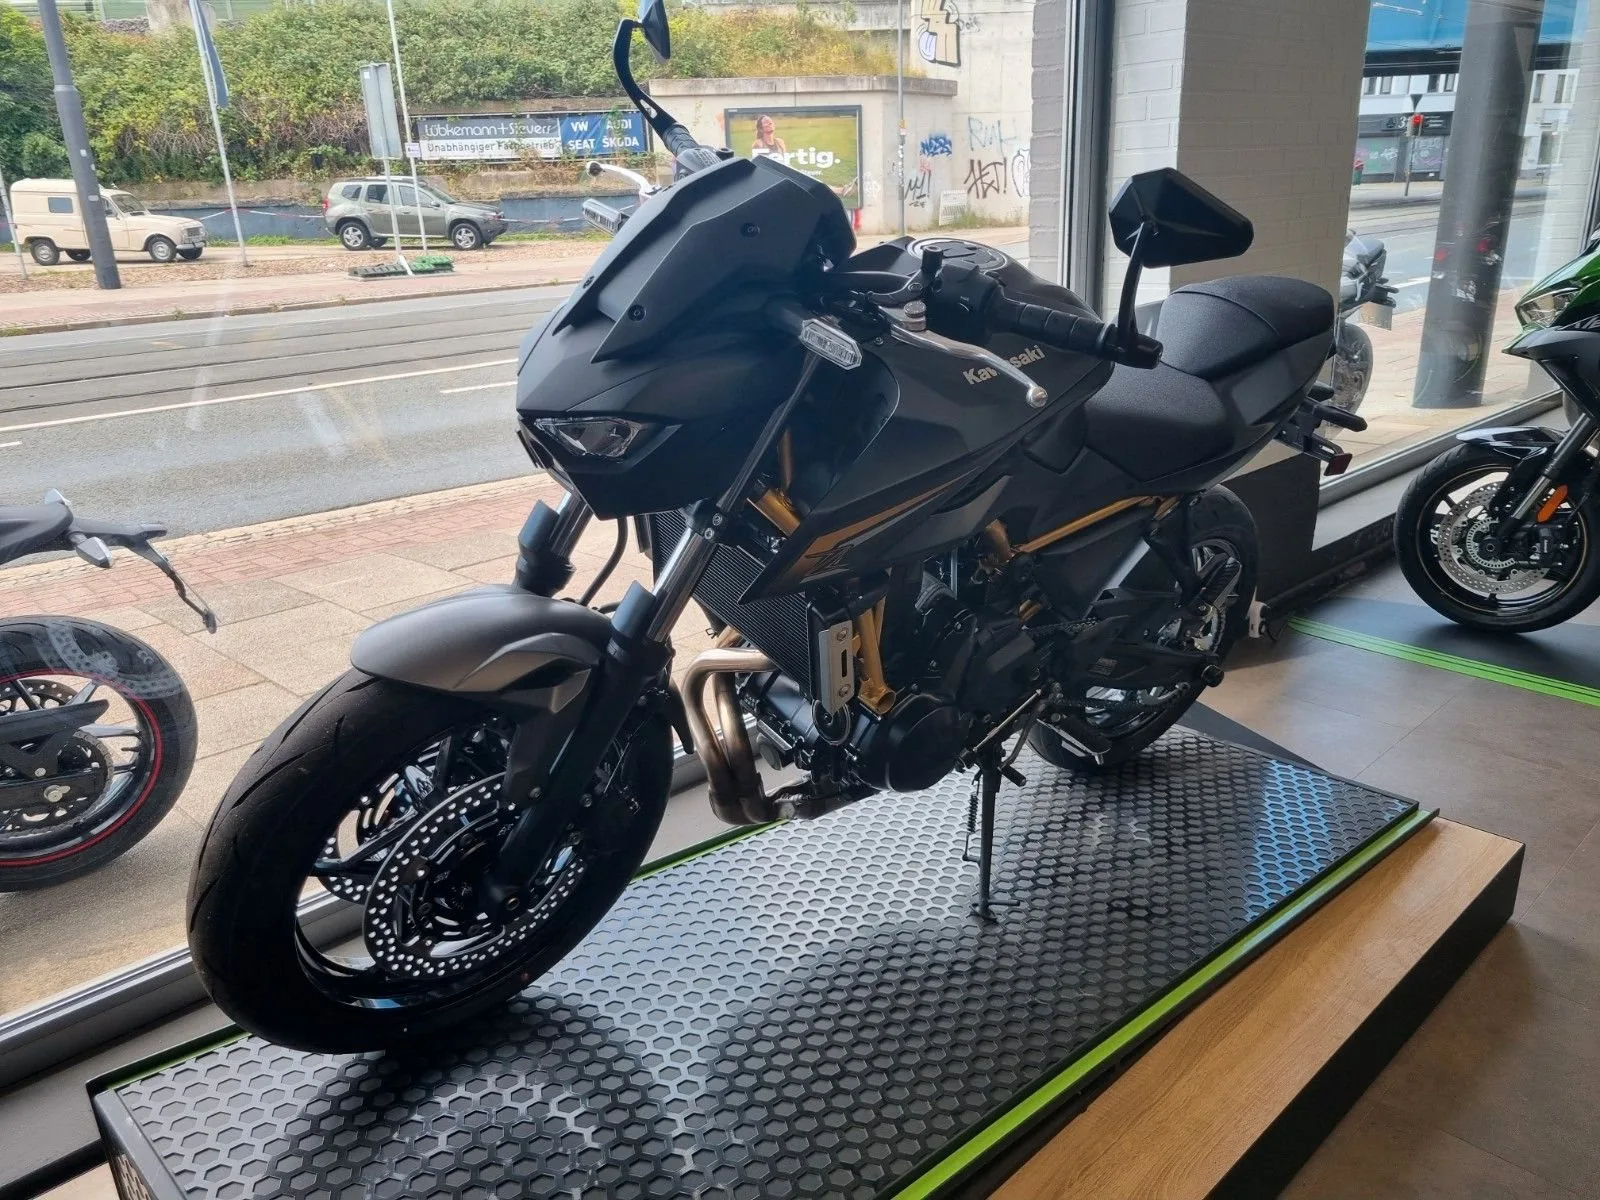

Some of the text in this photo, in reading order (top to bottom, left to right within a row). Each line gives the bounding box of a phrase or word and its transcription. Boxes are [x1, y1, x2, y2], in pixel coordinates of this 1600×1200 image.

[570, 118, 632, 132] VW AUDI
[568, 138, 596, 150] SEAT
[963, 344, 1046, 385] Kasaki
